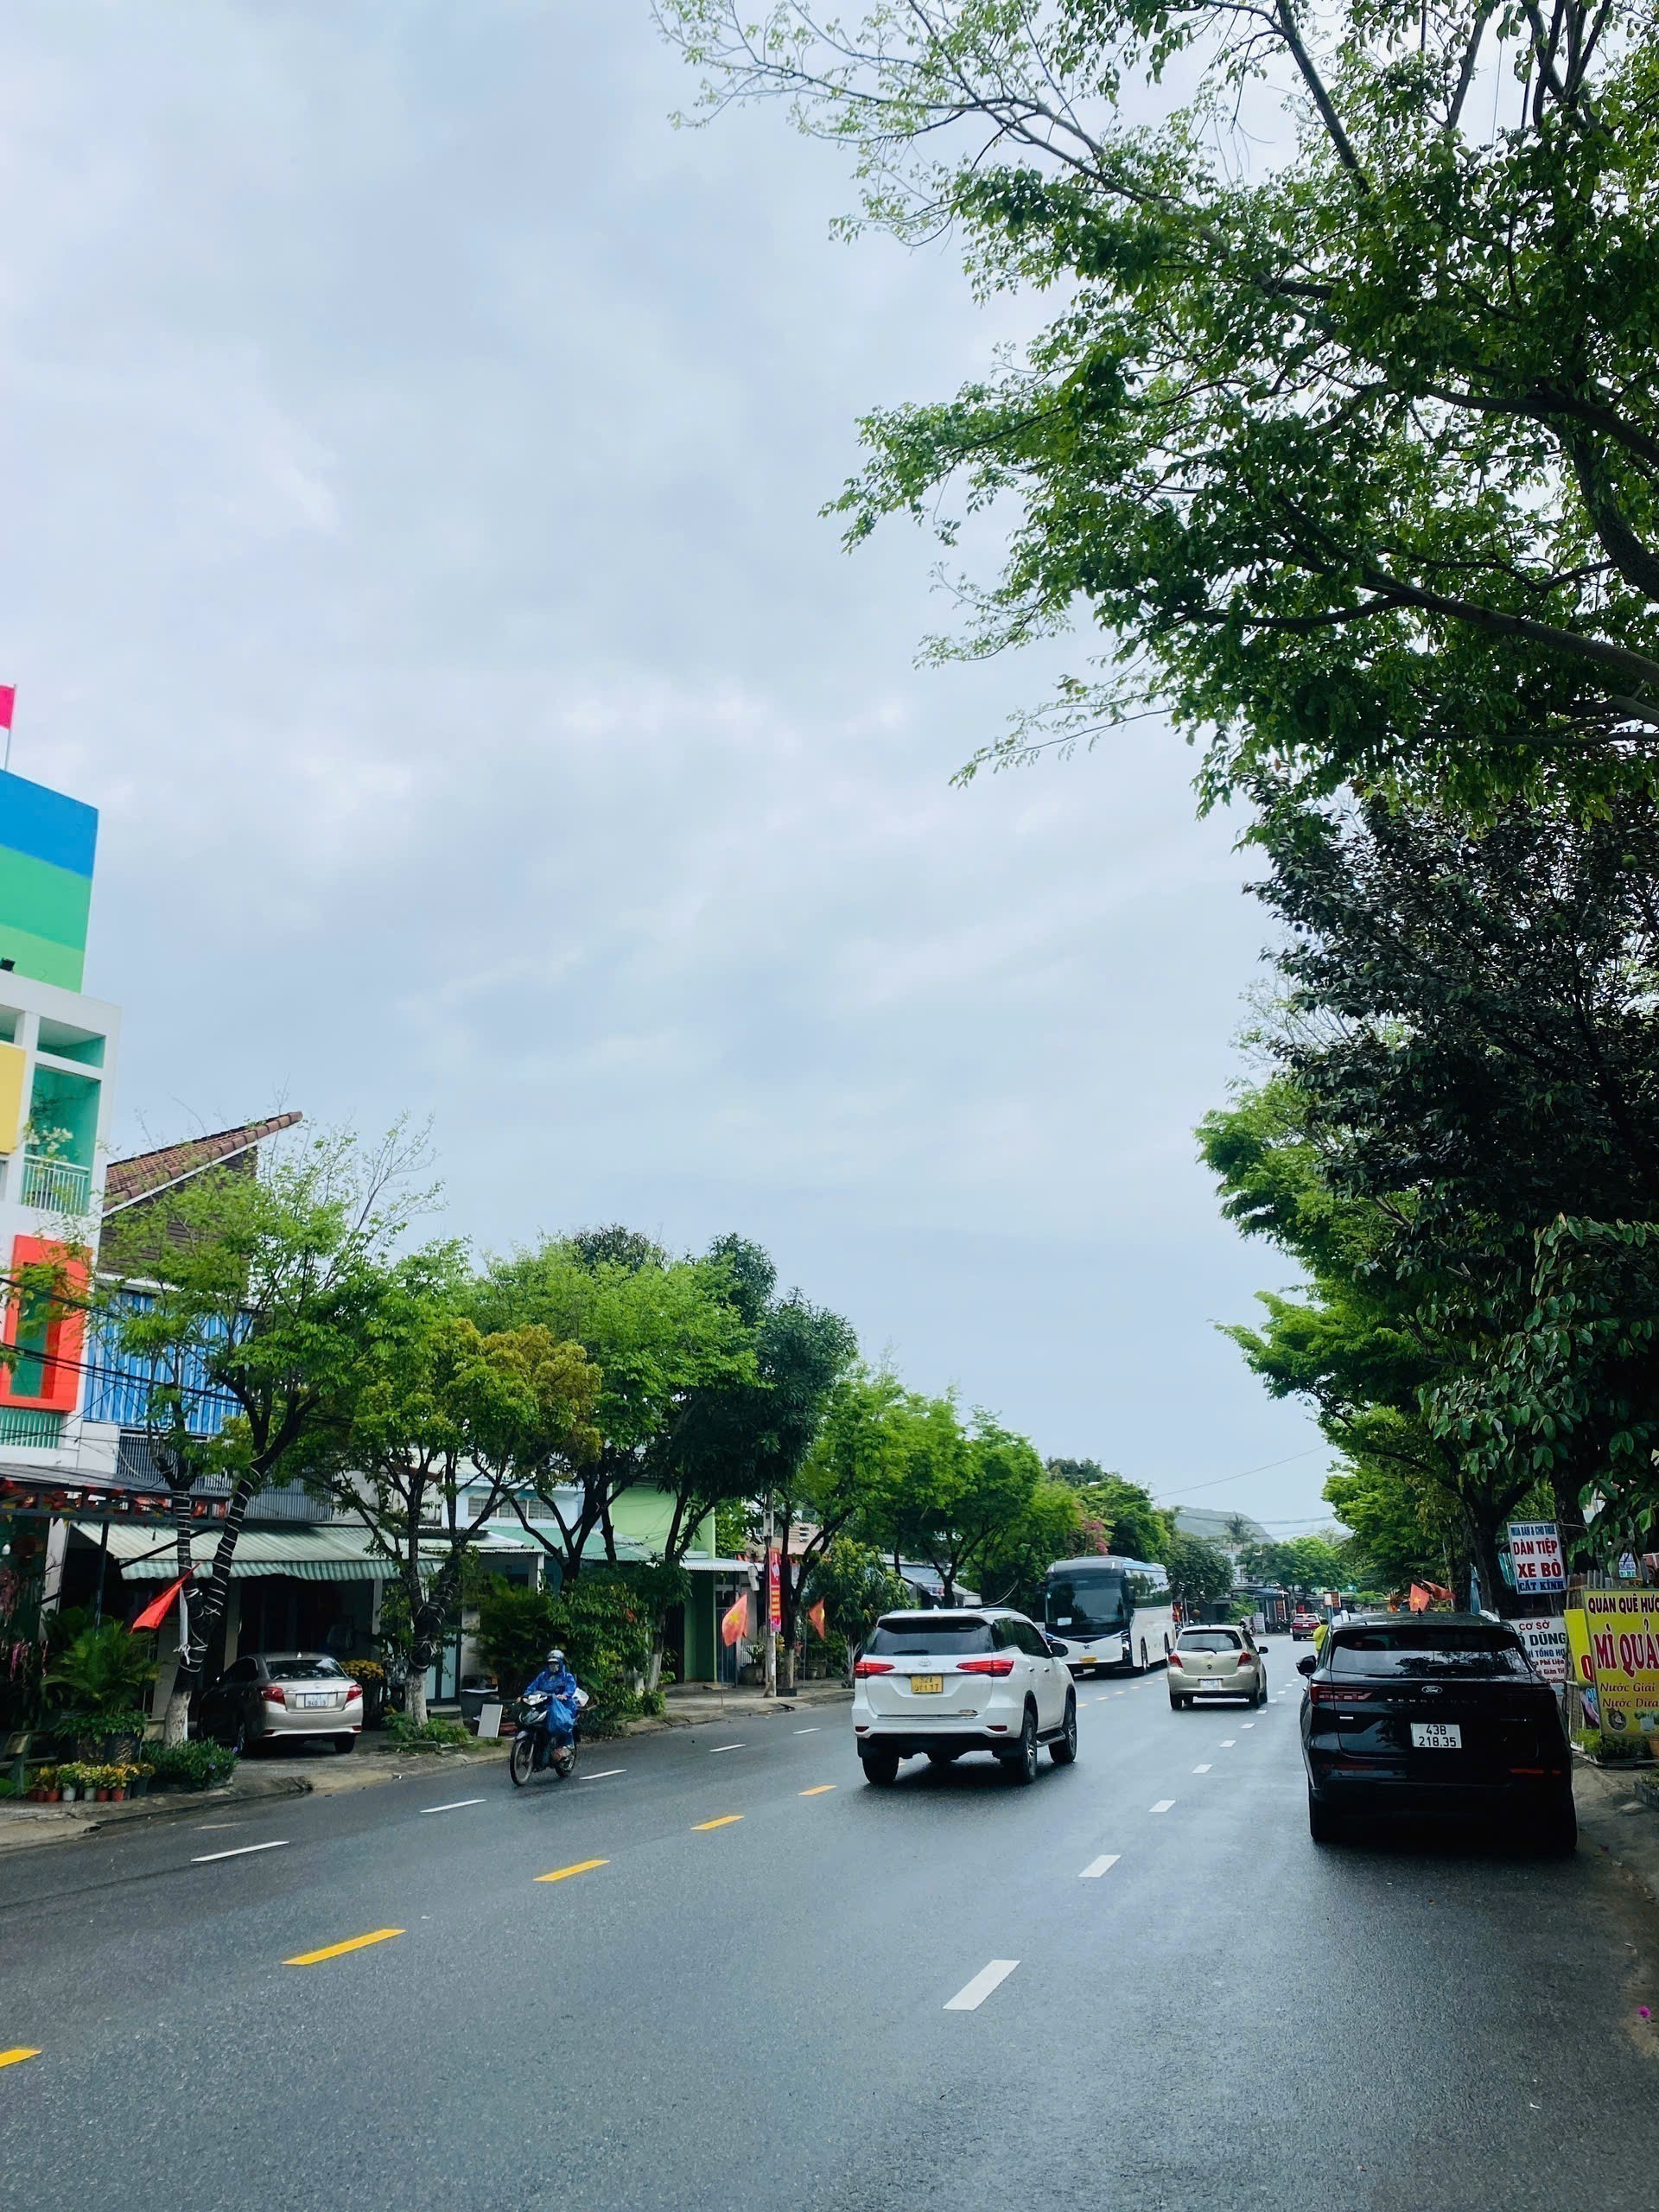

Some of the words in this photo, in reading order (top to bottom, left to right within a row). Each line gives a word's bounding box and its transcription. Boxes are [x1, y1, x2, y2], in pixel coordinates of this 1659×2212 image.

[1513, 1539, 1535, 1555] DÀN
[1535, 1538, 1558, 1557] TIỆP
[1516, 1563, 1537, 1578] XE
[1541, 1558, 1562, 1578] BÒ
[1588, 1592, 1617, 1614] QUÁN
[1618, 1592, 1639, 1614] QUÊ
[1519, 1622, 1534, 1630] CƠ
[1536, 1620, 1550, 1630] SỞ
[1529, 1631, 1567, 1646] DŨNG
[1593, 1623, 1618, 1669] MÌ
[1426, 1725, 1446, 1735] 43B
[1418, 1736, 1457, 1747] 218.35
